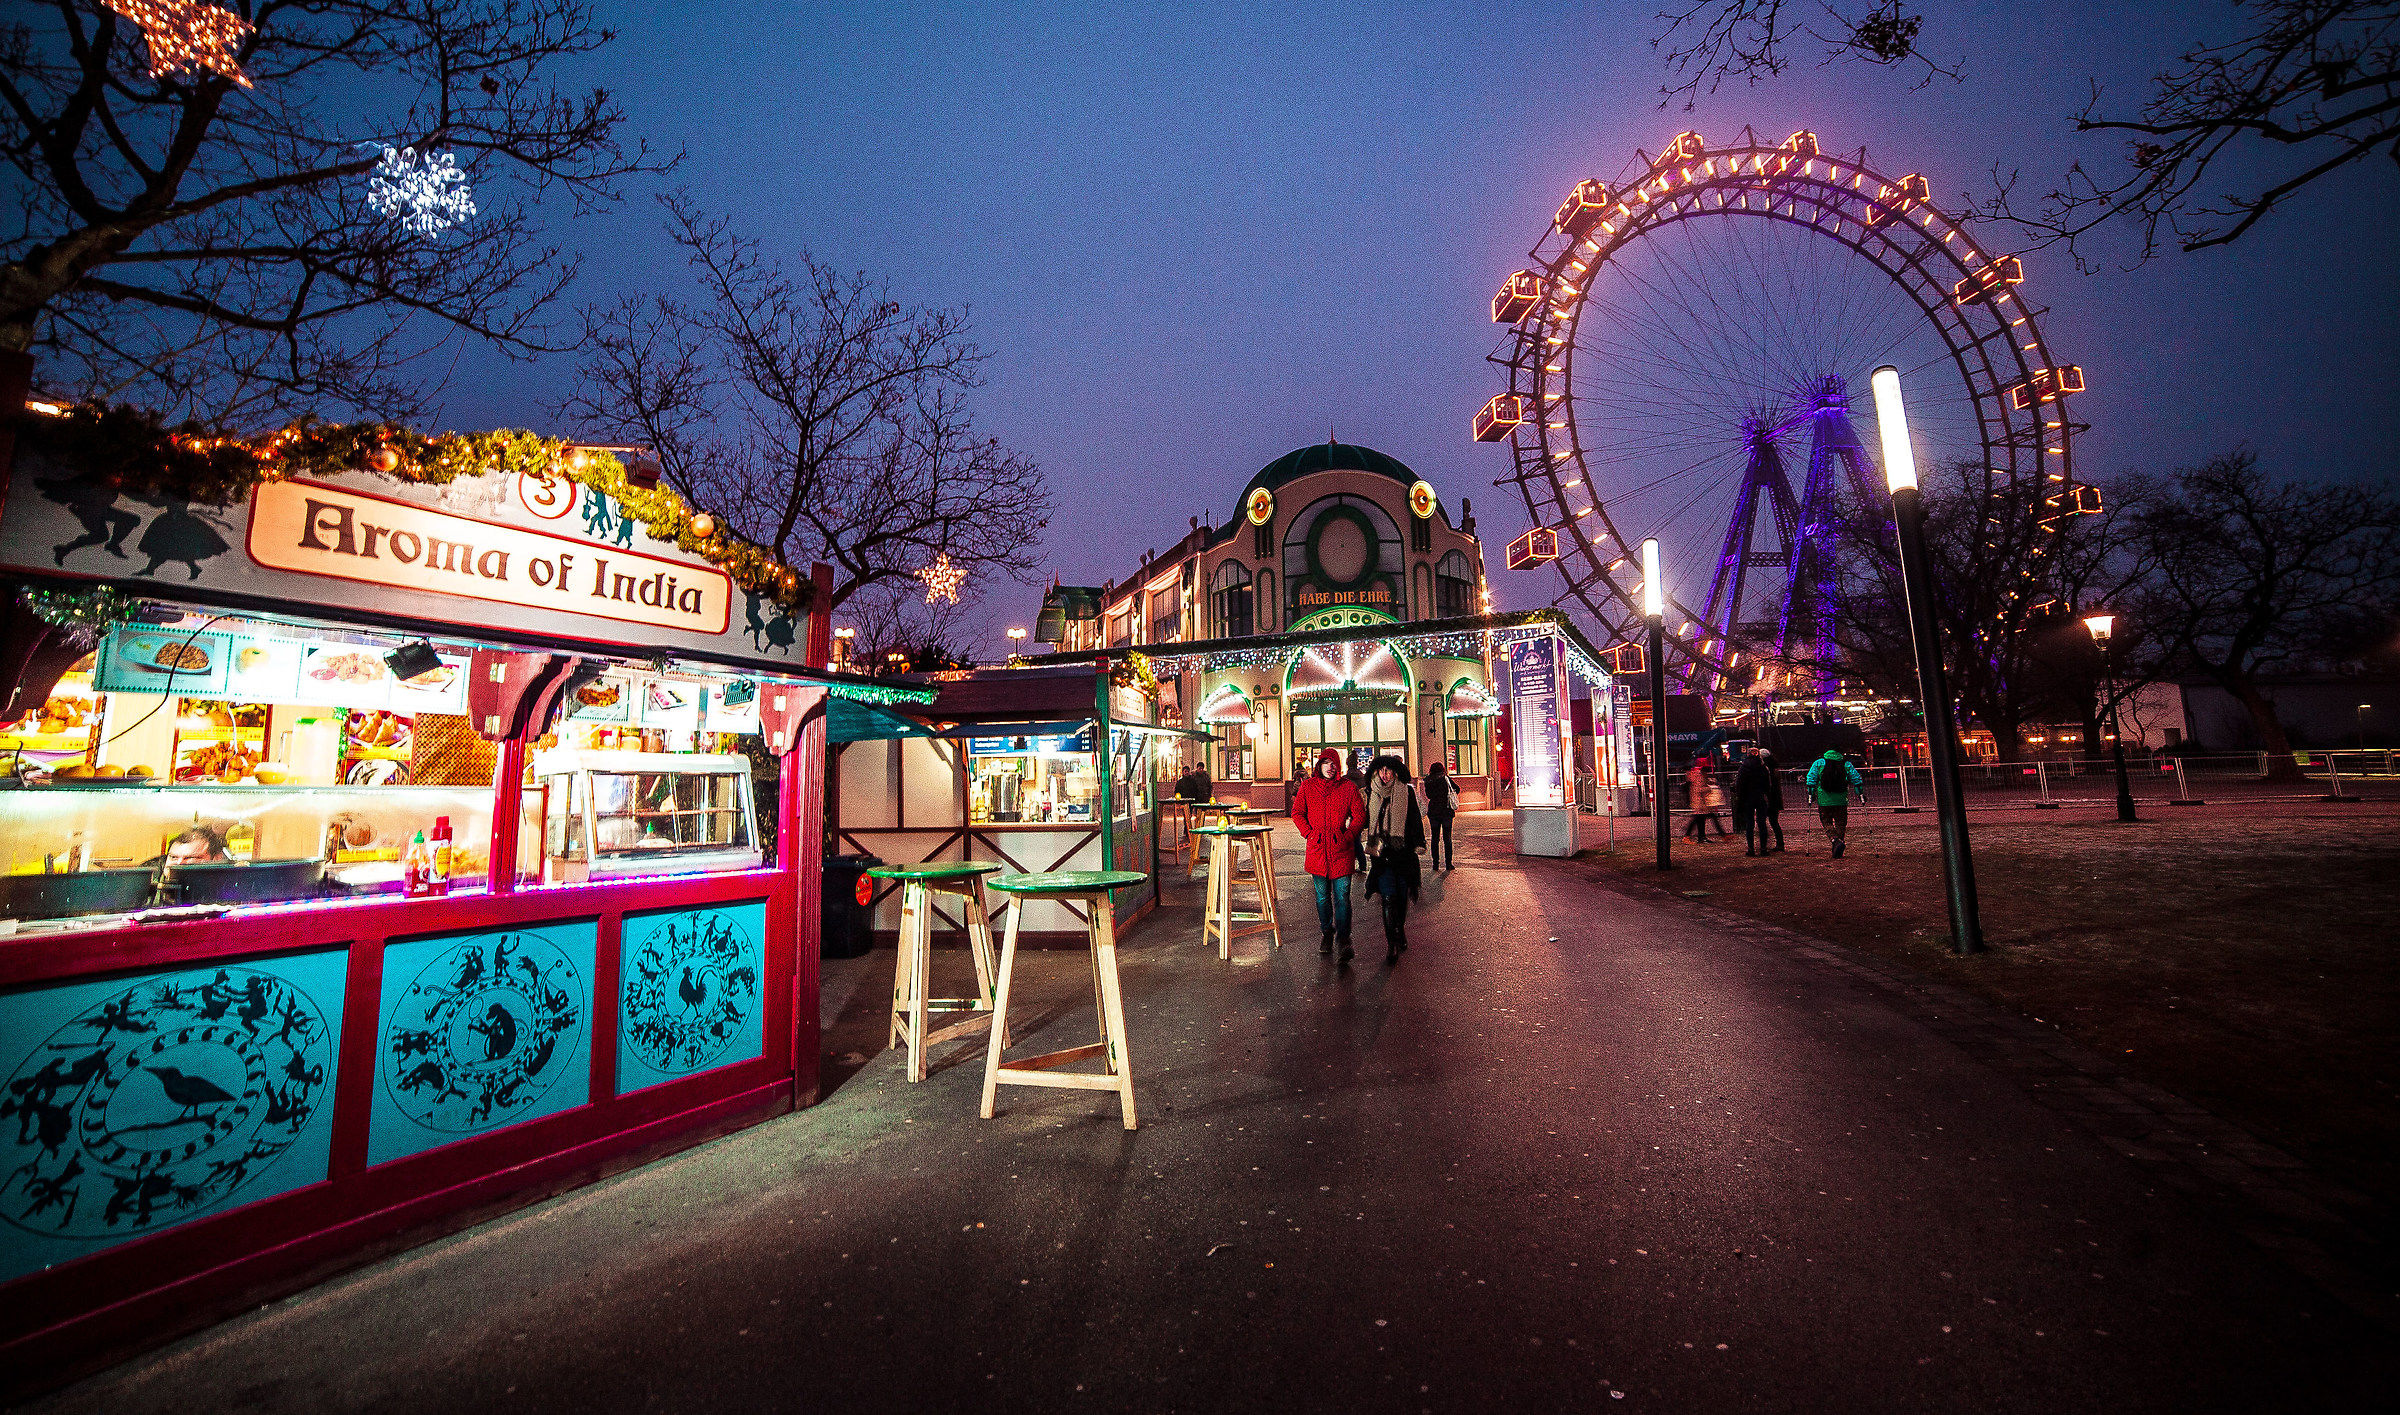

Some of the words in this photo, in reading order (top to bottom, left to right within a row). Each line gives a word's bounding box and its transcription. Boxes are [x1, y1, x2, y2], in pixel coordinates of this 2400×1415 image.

[534, 476, 556, 506] 3
[298, 497, 510, 581] Aroma
[528, 553, 574, 592] of
[591, 557, 703, 615] India
[1299, 592, 1331, 605] HABE
[1334, 591, 1356, 604] DIE
[1359, 590, 1392, 603] EHRE
